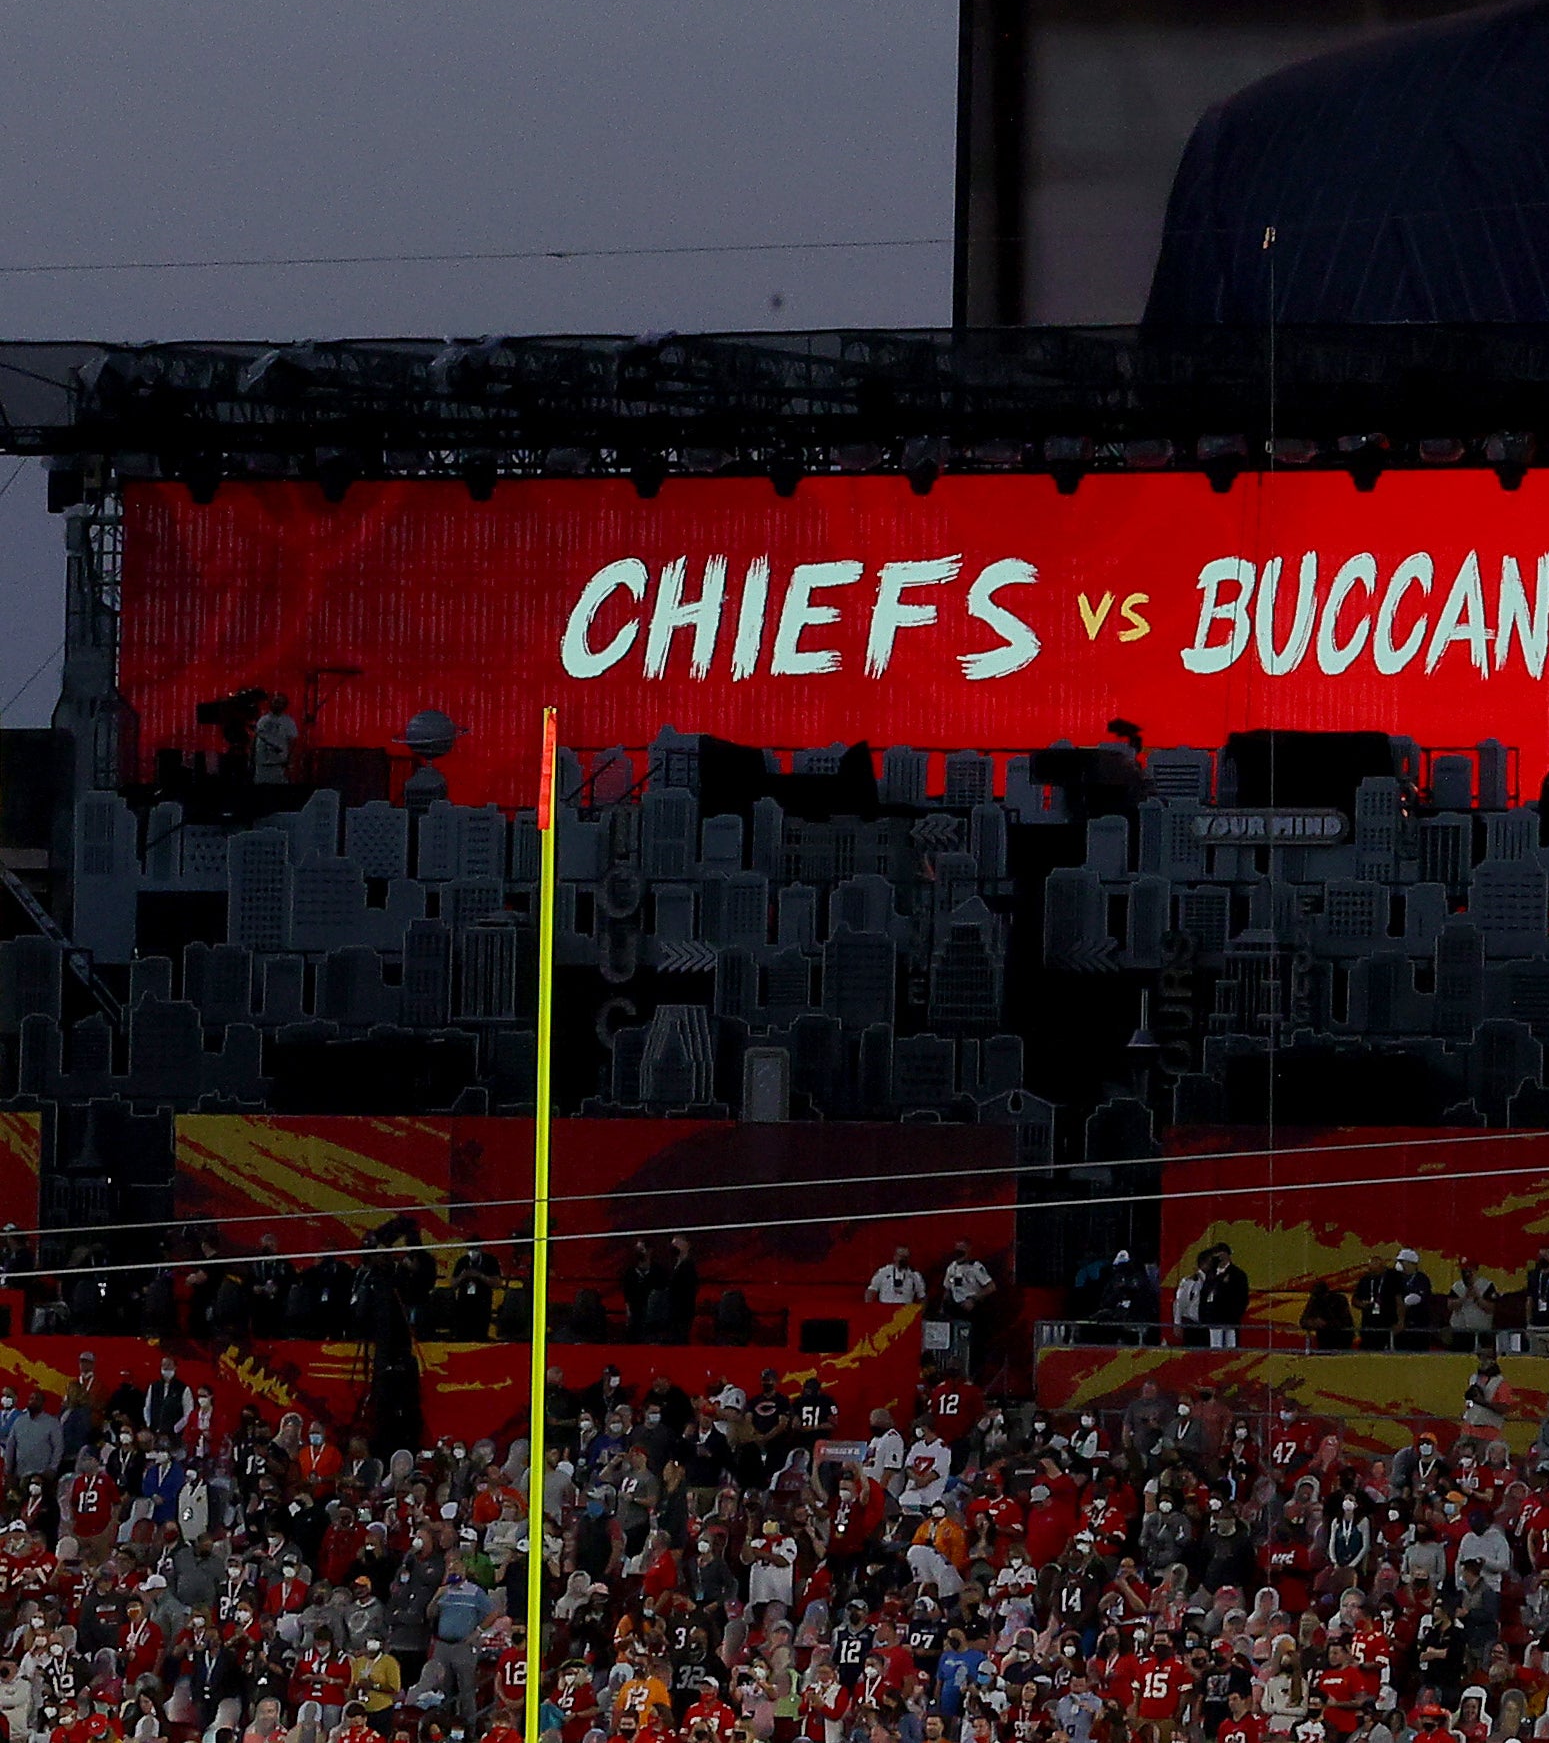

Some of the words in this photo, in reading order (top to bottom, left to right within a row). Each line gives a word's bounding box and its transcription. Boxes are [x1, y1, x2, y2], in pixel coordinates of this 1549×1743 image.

[561, 551, 1041, 682] CHIEFS
[1193, 815, 1265, 837] YOUR
[939, 1394, 959, 1414] 12
[802, 1406, 819, 1426] 51
[246, 1454, 265, 1474] 12
[1273, 1442, 1296, 1463] 47
[78, 1491, 97, 1513] 12
[1062, 1588, 1081, 1612] 14
[840, 1640, 861, 1663] 12
[505, 1661, 527, 1685] 12
[677, 1665, 705, 1689] 32
[1143, 1672, 1169, 1698] 15
[624, 1687, 649, 1711] 12
